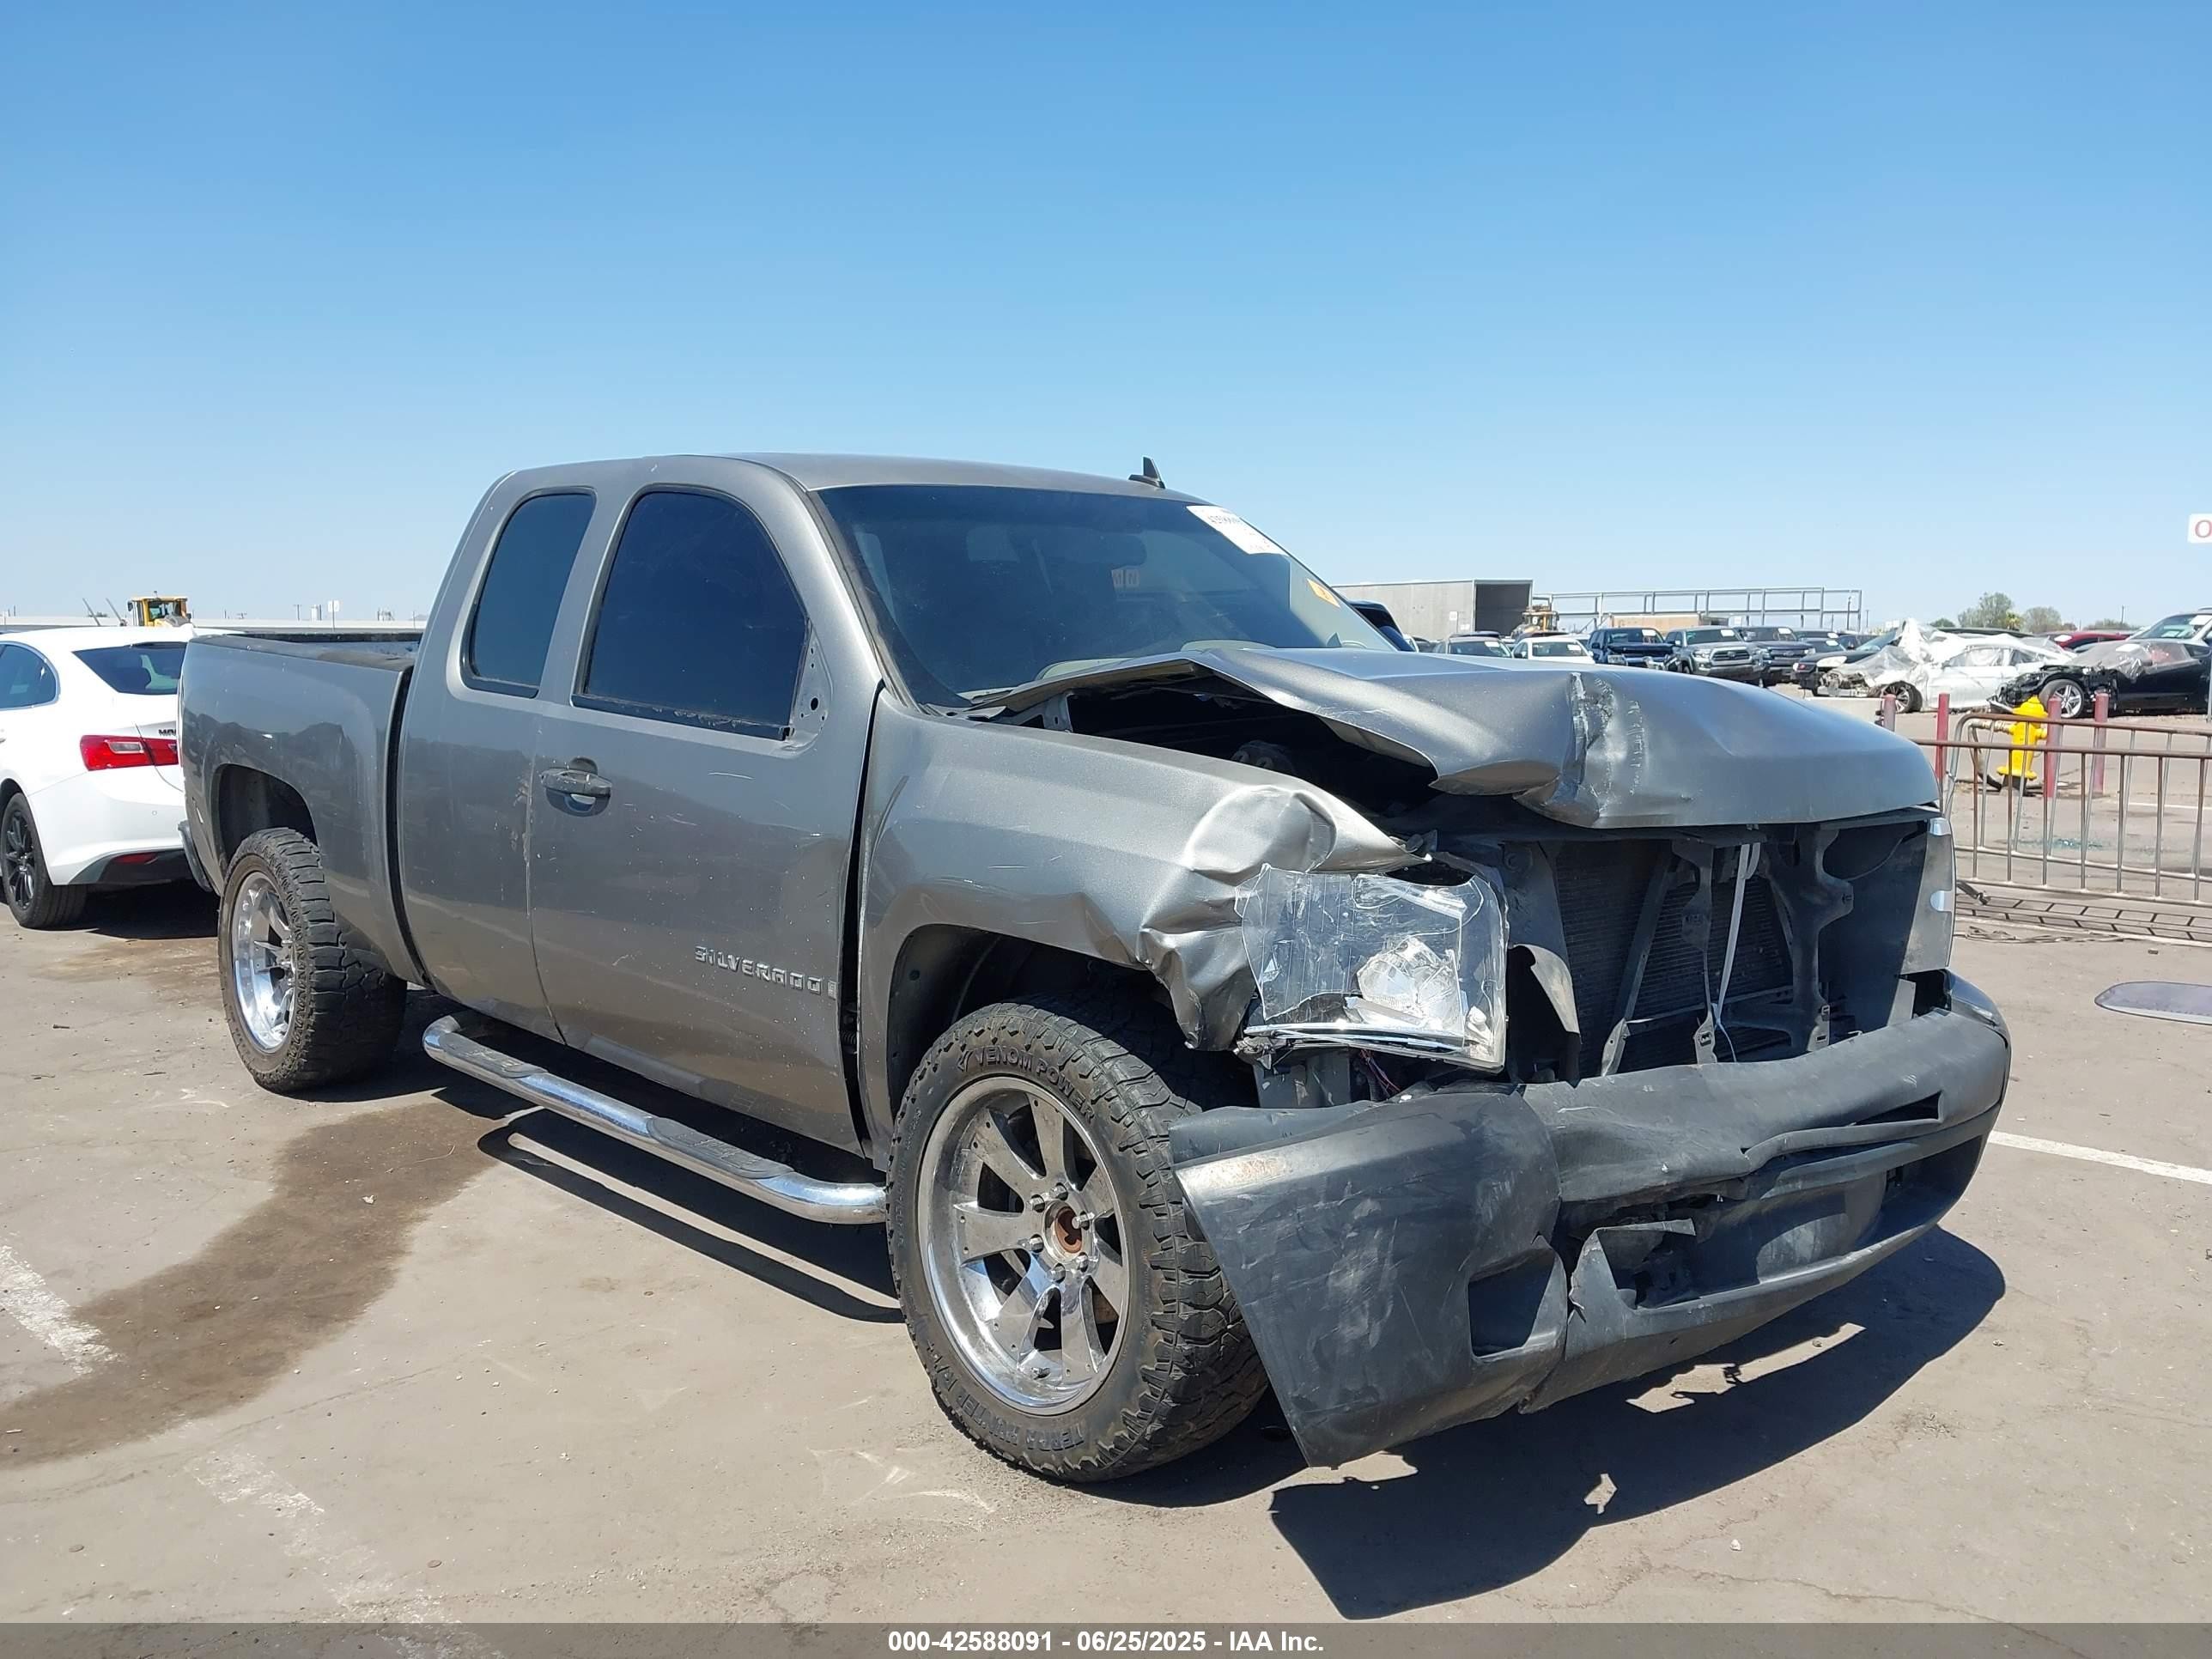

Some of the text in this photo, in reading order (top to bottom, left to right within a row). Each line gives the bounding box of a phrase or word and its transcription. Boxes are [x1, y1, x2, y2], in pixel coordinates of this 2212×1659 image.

[694, 945, 823, 995] SILVERADO
[975, 1046, 1095, 1123] VENOM POWER
